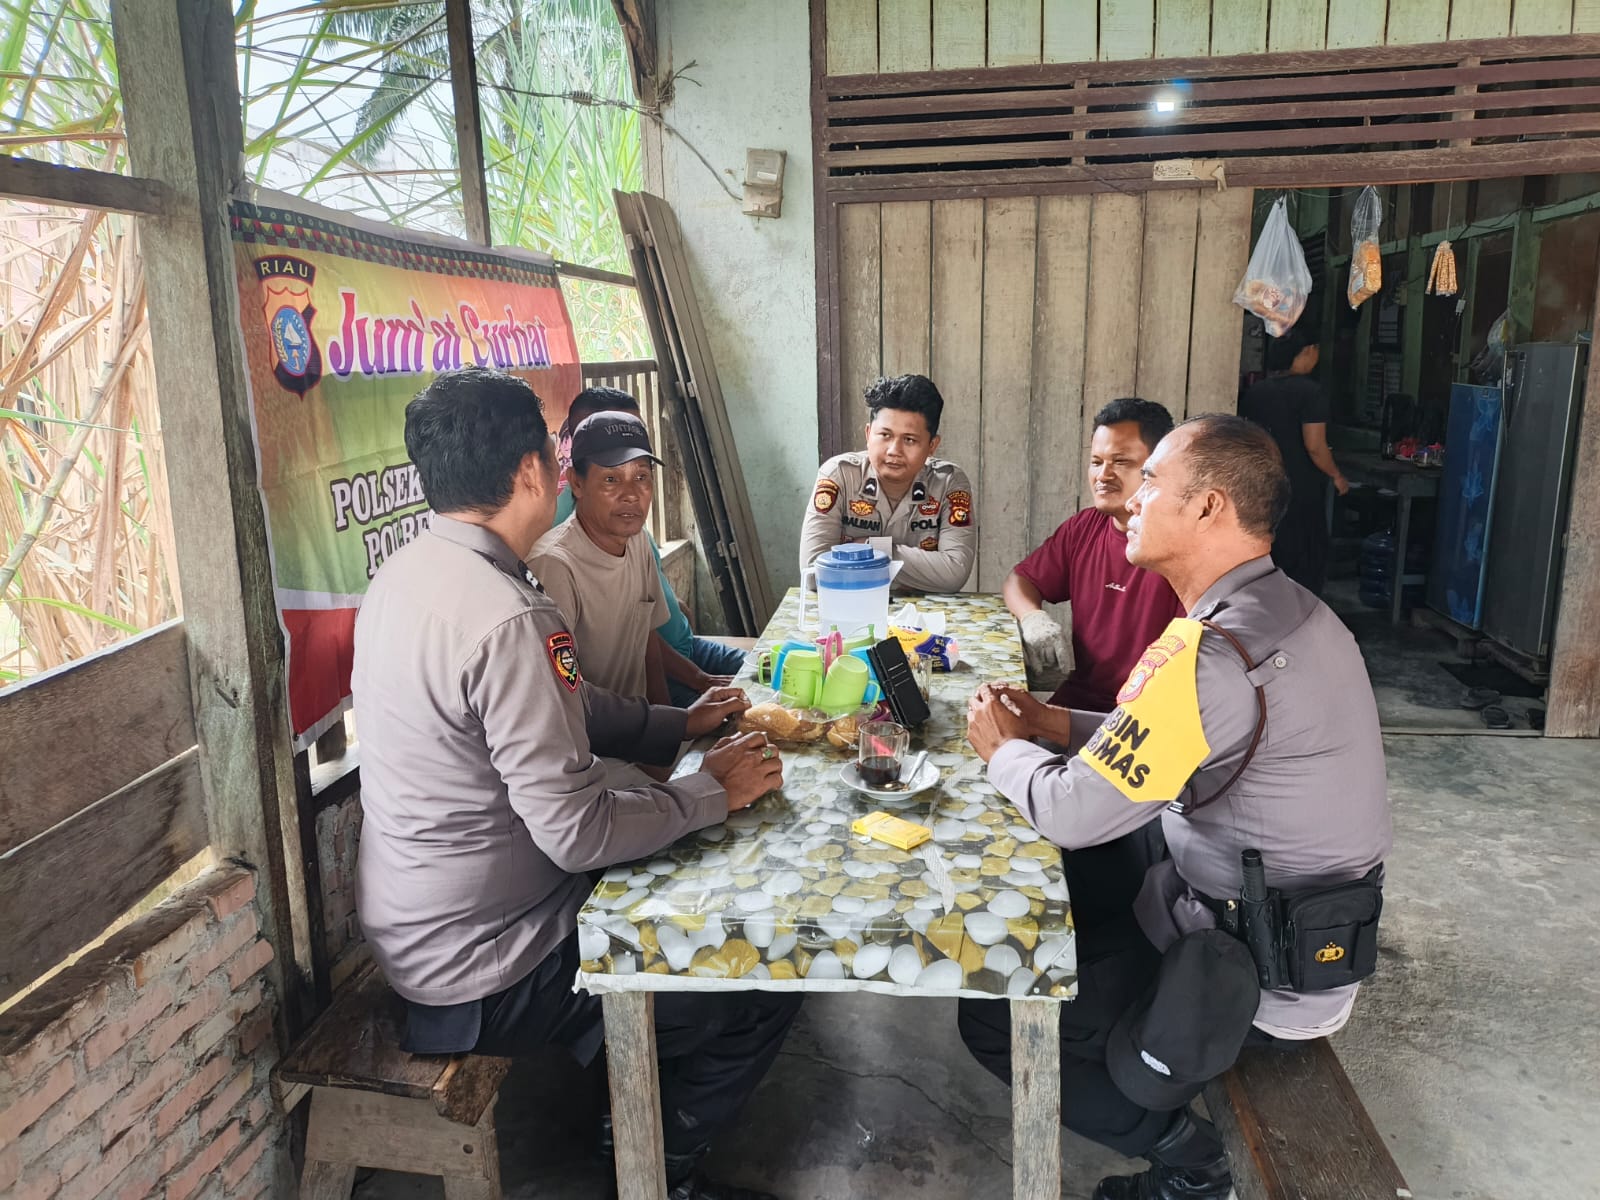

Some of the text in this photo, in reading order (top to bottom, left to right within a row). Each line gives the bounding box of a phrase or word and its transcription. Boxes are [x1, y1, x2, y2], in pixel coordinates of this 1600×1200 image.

[260, 259, 308, 278] RIAU
[460, 304, 551, 368] Curhat
[330, 462, 425, 532] POLSEK
[1103, 707, 1151, 751] BIN
